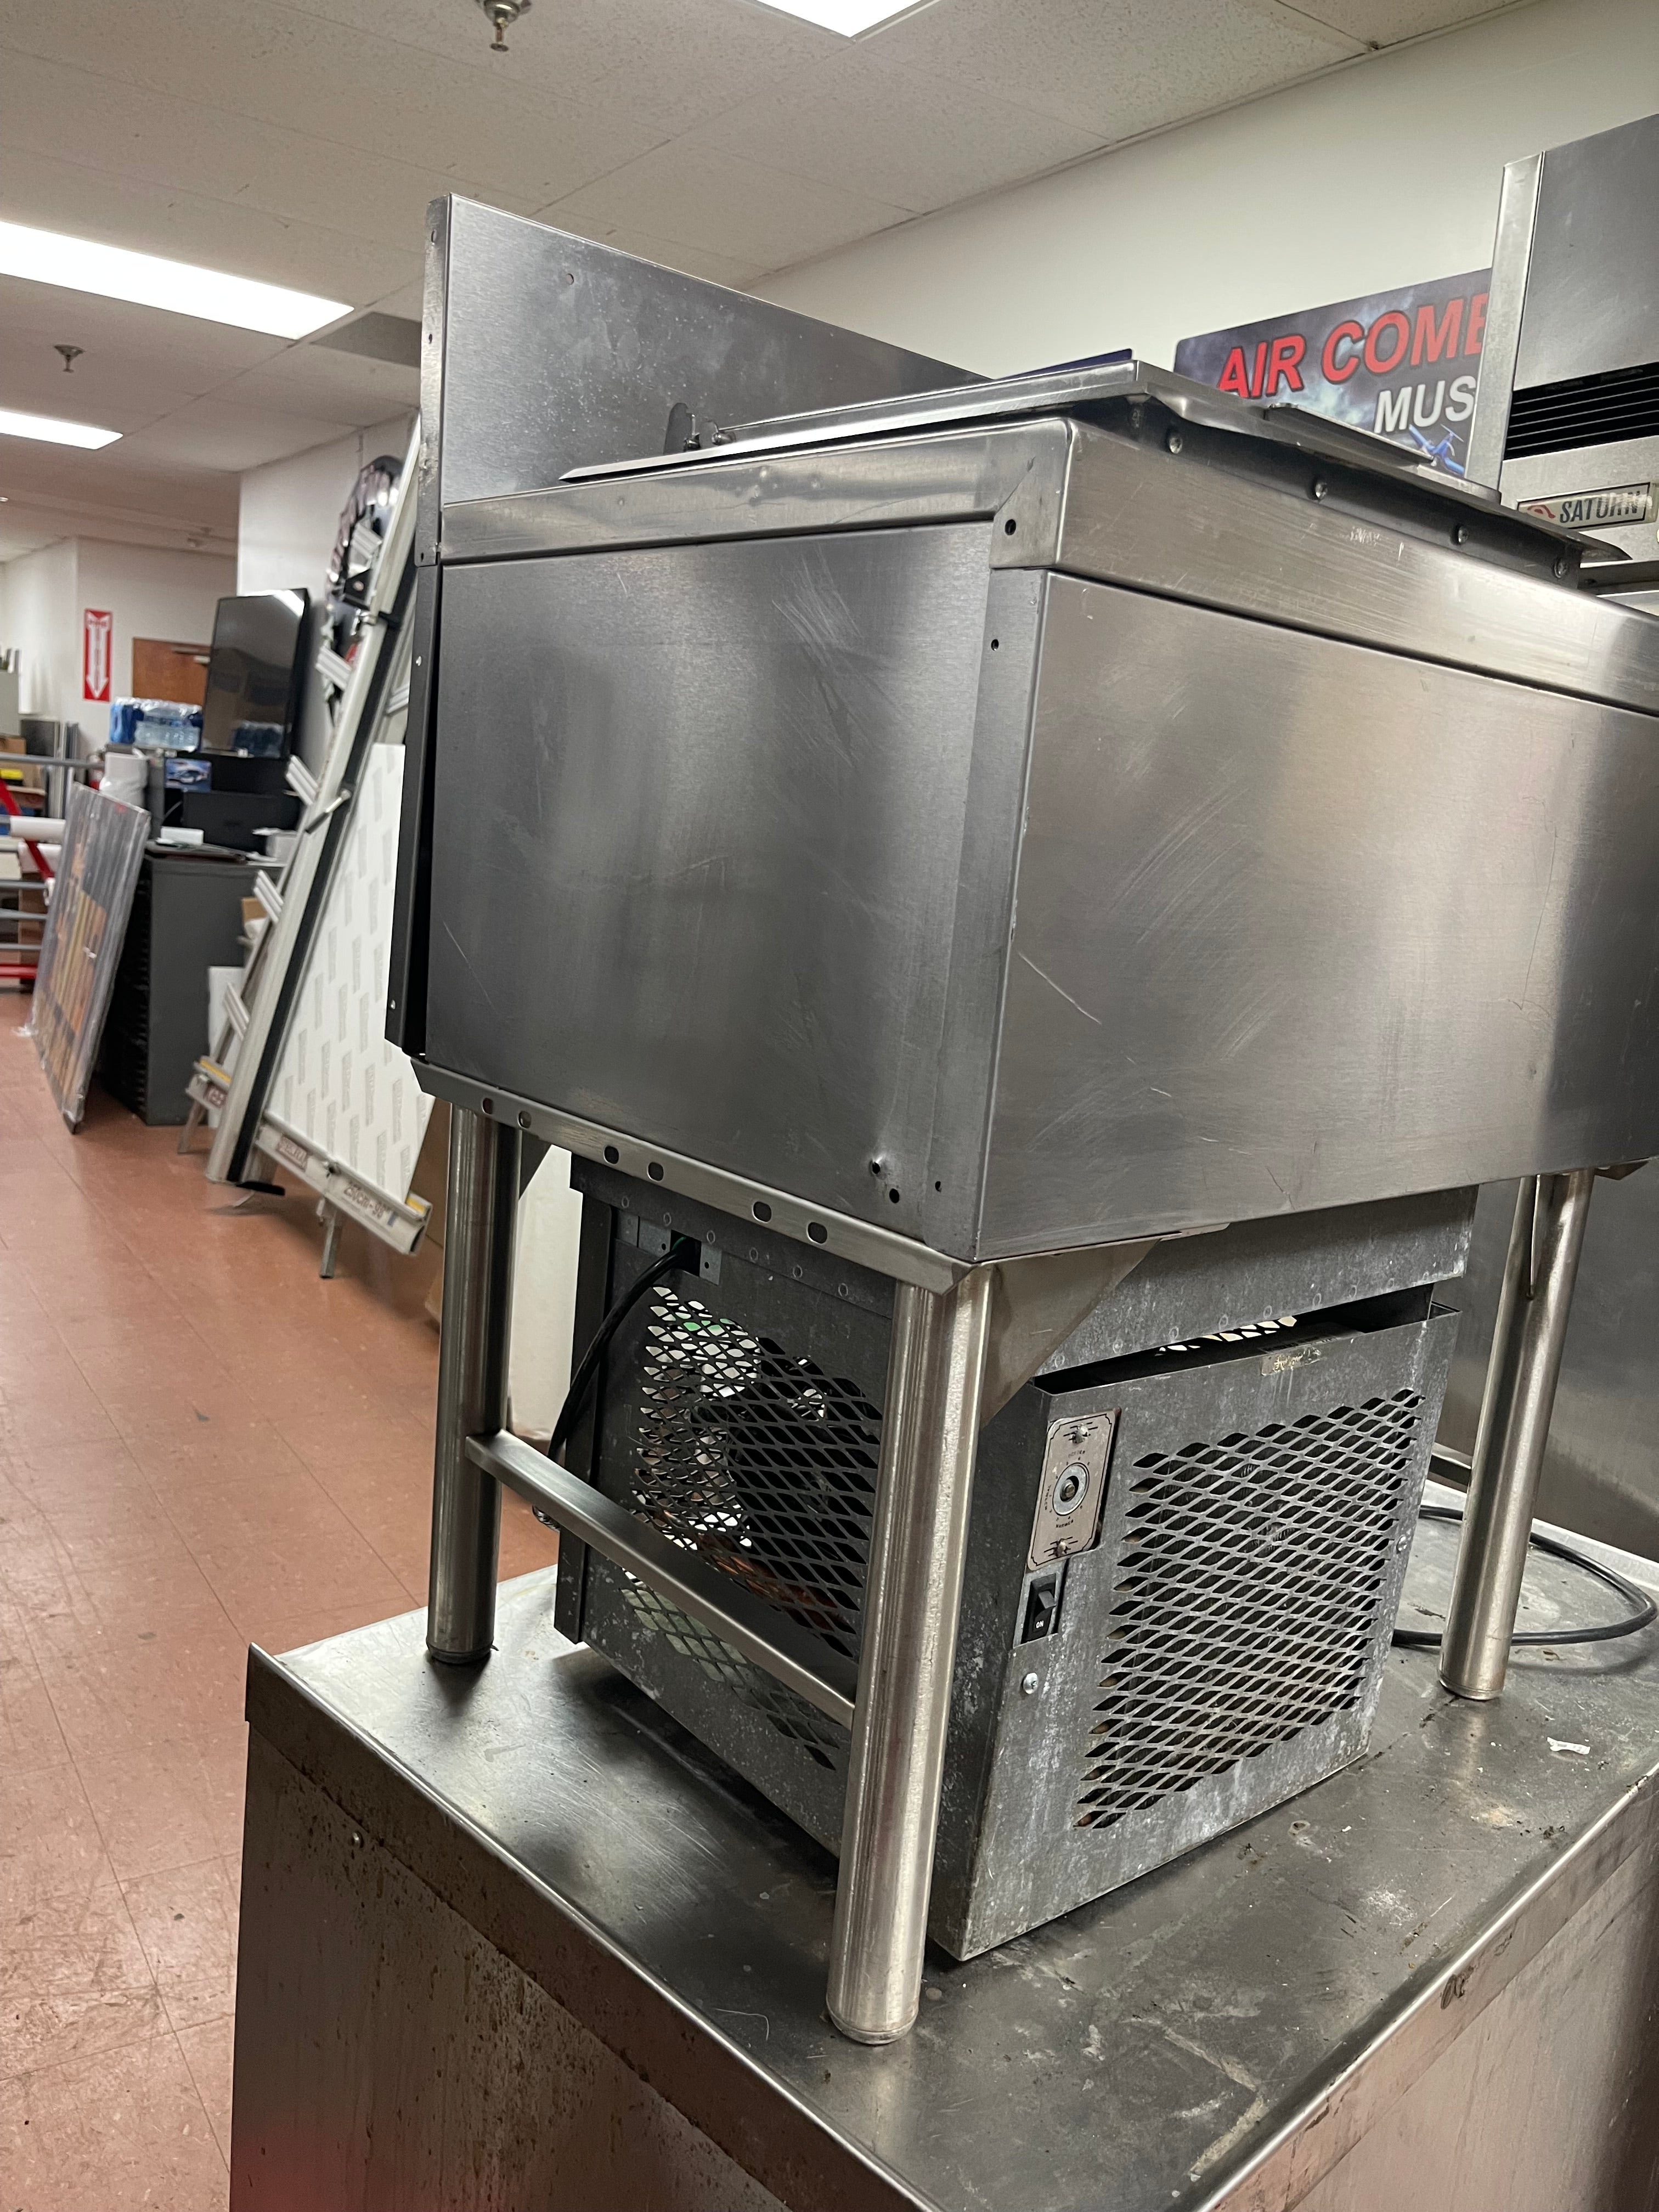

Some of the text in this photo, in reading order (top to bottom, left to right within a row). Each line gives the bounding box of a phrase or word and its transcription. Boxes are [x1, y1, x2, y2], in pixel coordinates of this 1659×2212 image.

[1217, 334, 1306, 398] AIR
[1373, 375, 1477, 434] MUS
[1036, 1620, 1044, 1629] ON
